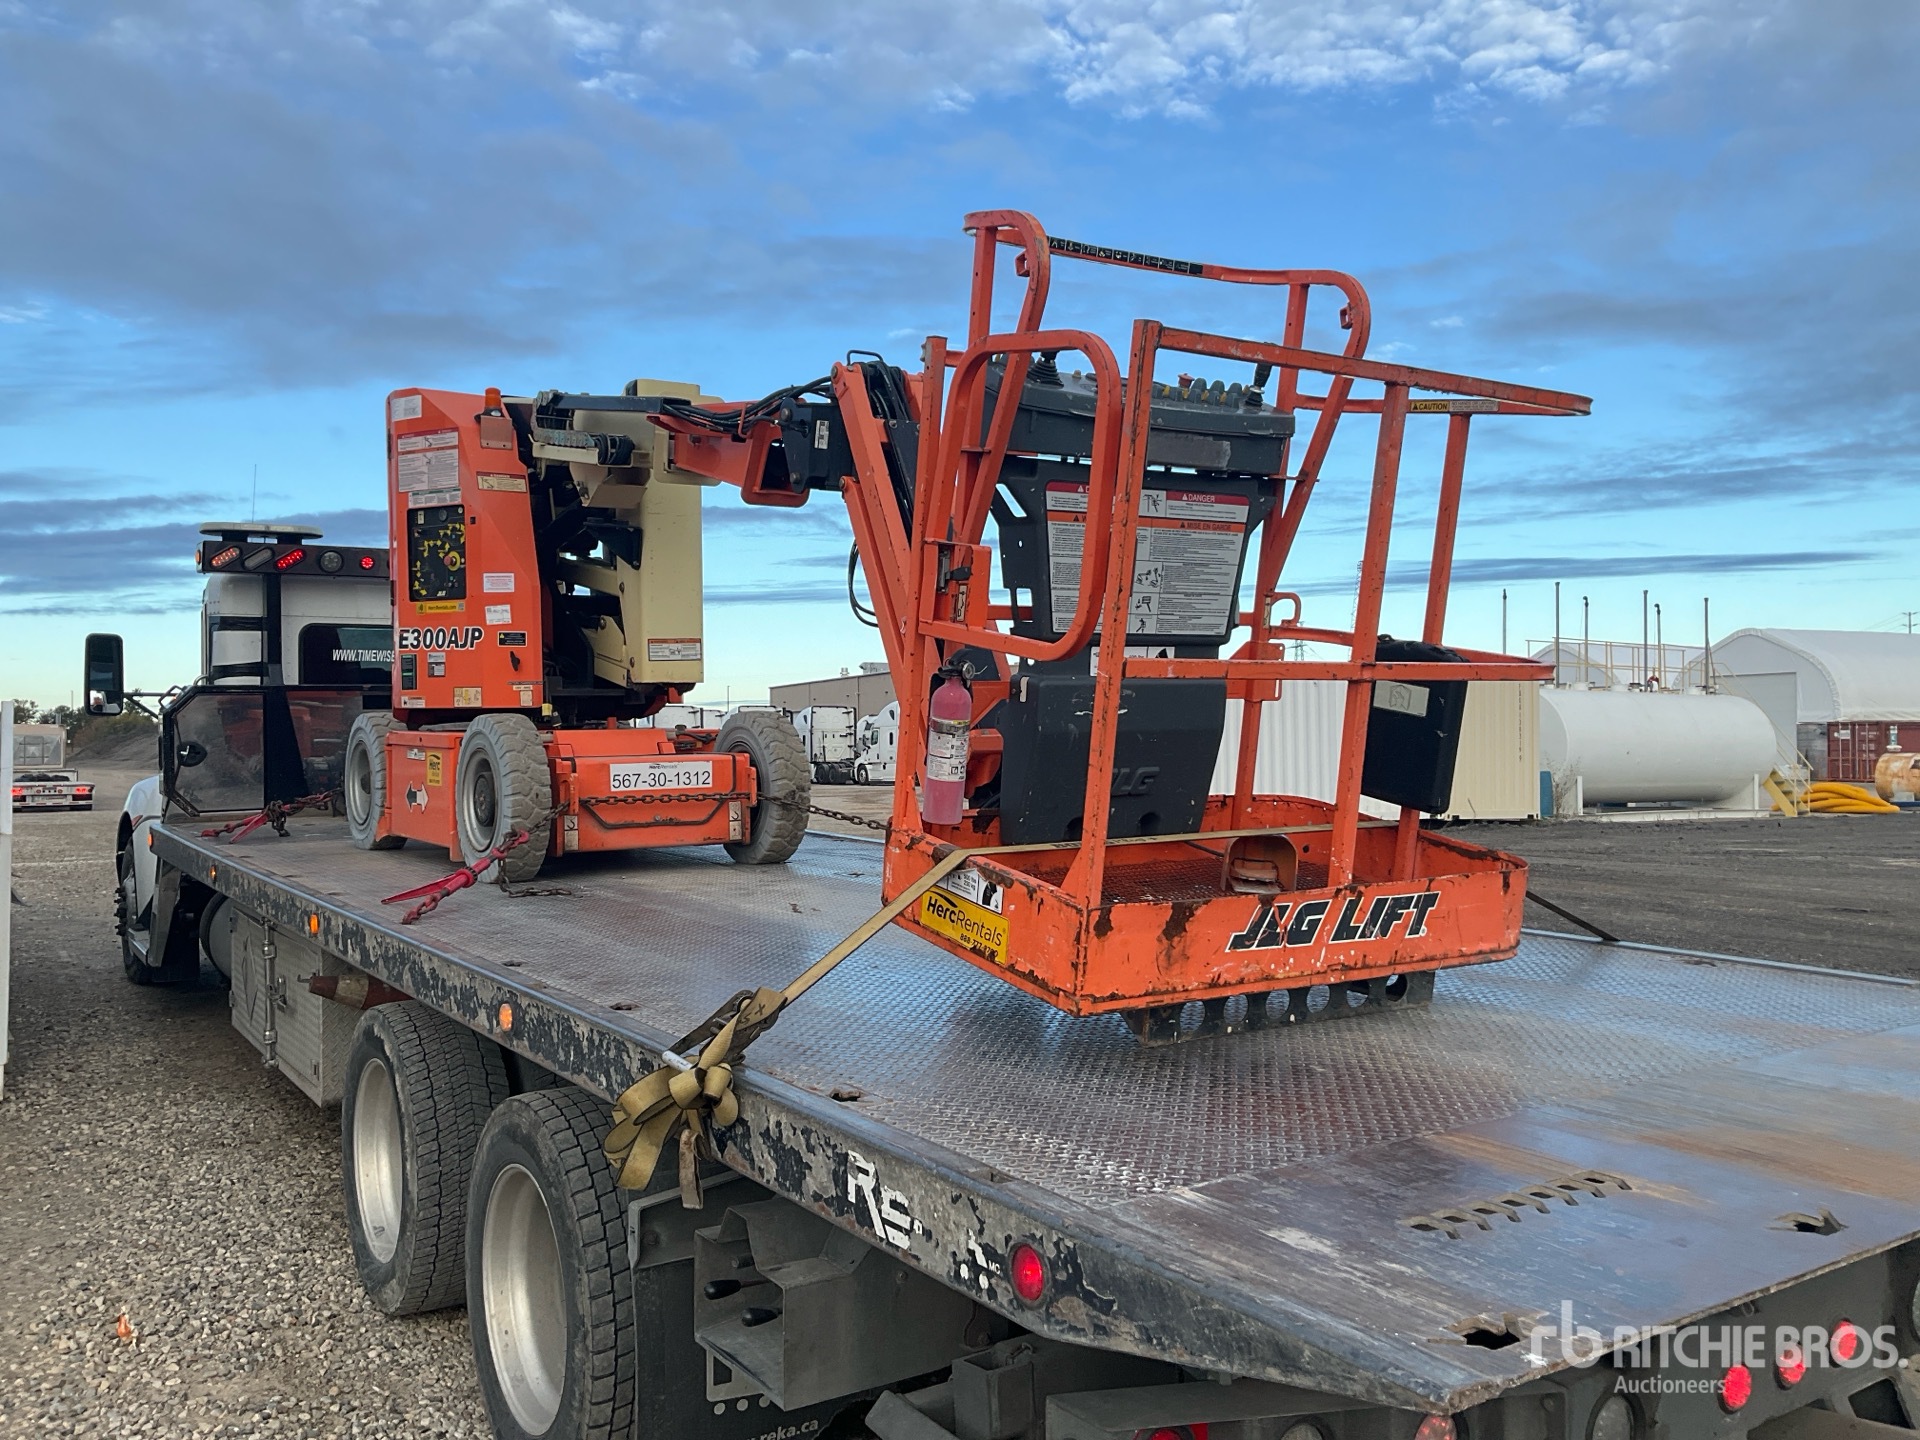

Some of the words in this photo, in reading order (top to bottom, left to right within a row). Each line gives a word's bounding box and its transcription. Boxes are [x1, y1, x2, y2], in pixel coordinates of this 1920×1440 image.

[1188, 493, 1215, 503] DANGER
[1187, 521, 1201, 530] MISE
[1203, 522, 1211, 530] EN
[399, 626, 484, 650] E300AJP
[612, 770, 711, 789] 567-30-1312
[927, 896, 1002, 947] HercRentals
[1329, 891, 1441, 944] LIFT
